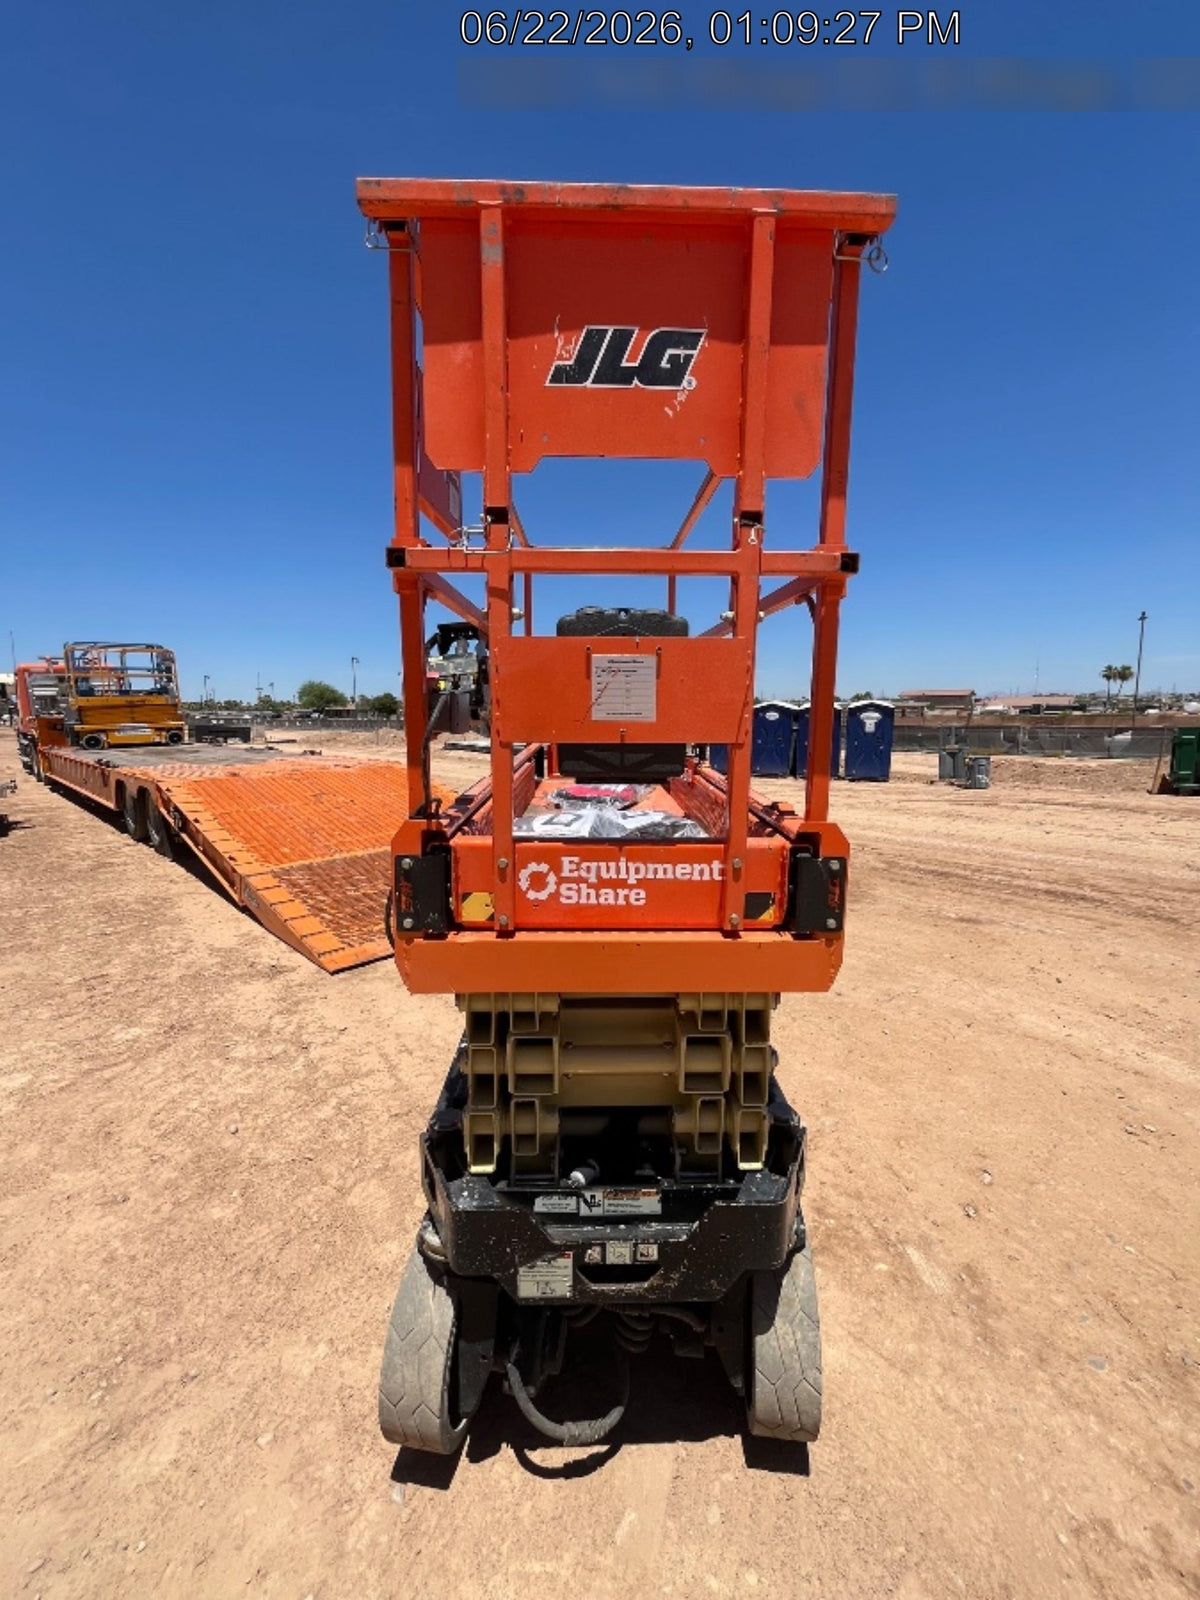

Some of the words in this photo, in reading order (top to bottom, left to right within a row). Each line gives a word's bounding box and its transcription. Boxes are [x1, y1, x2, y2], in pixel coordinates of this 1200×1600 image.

[545, 325, 708, 390] JLG
[560, 856, 725, 884] Equipment
[559, 883, 647, 906] Share
